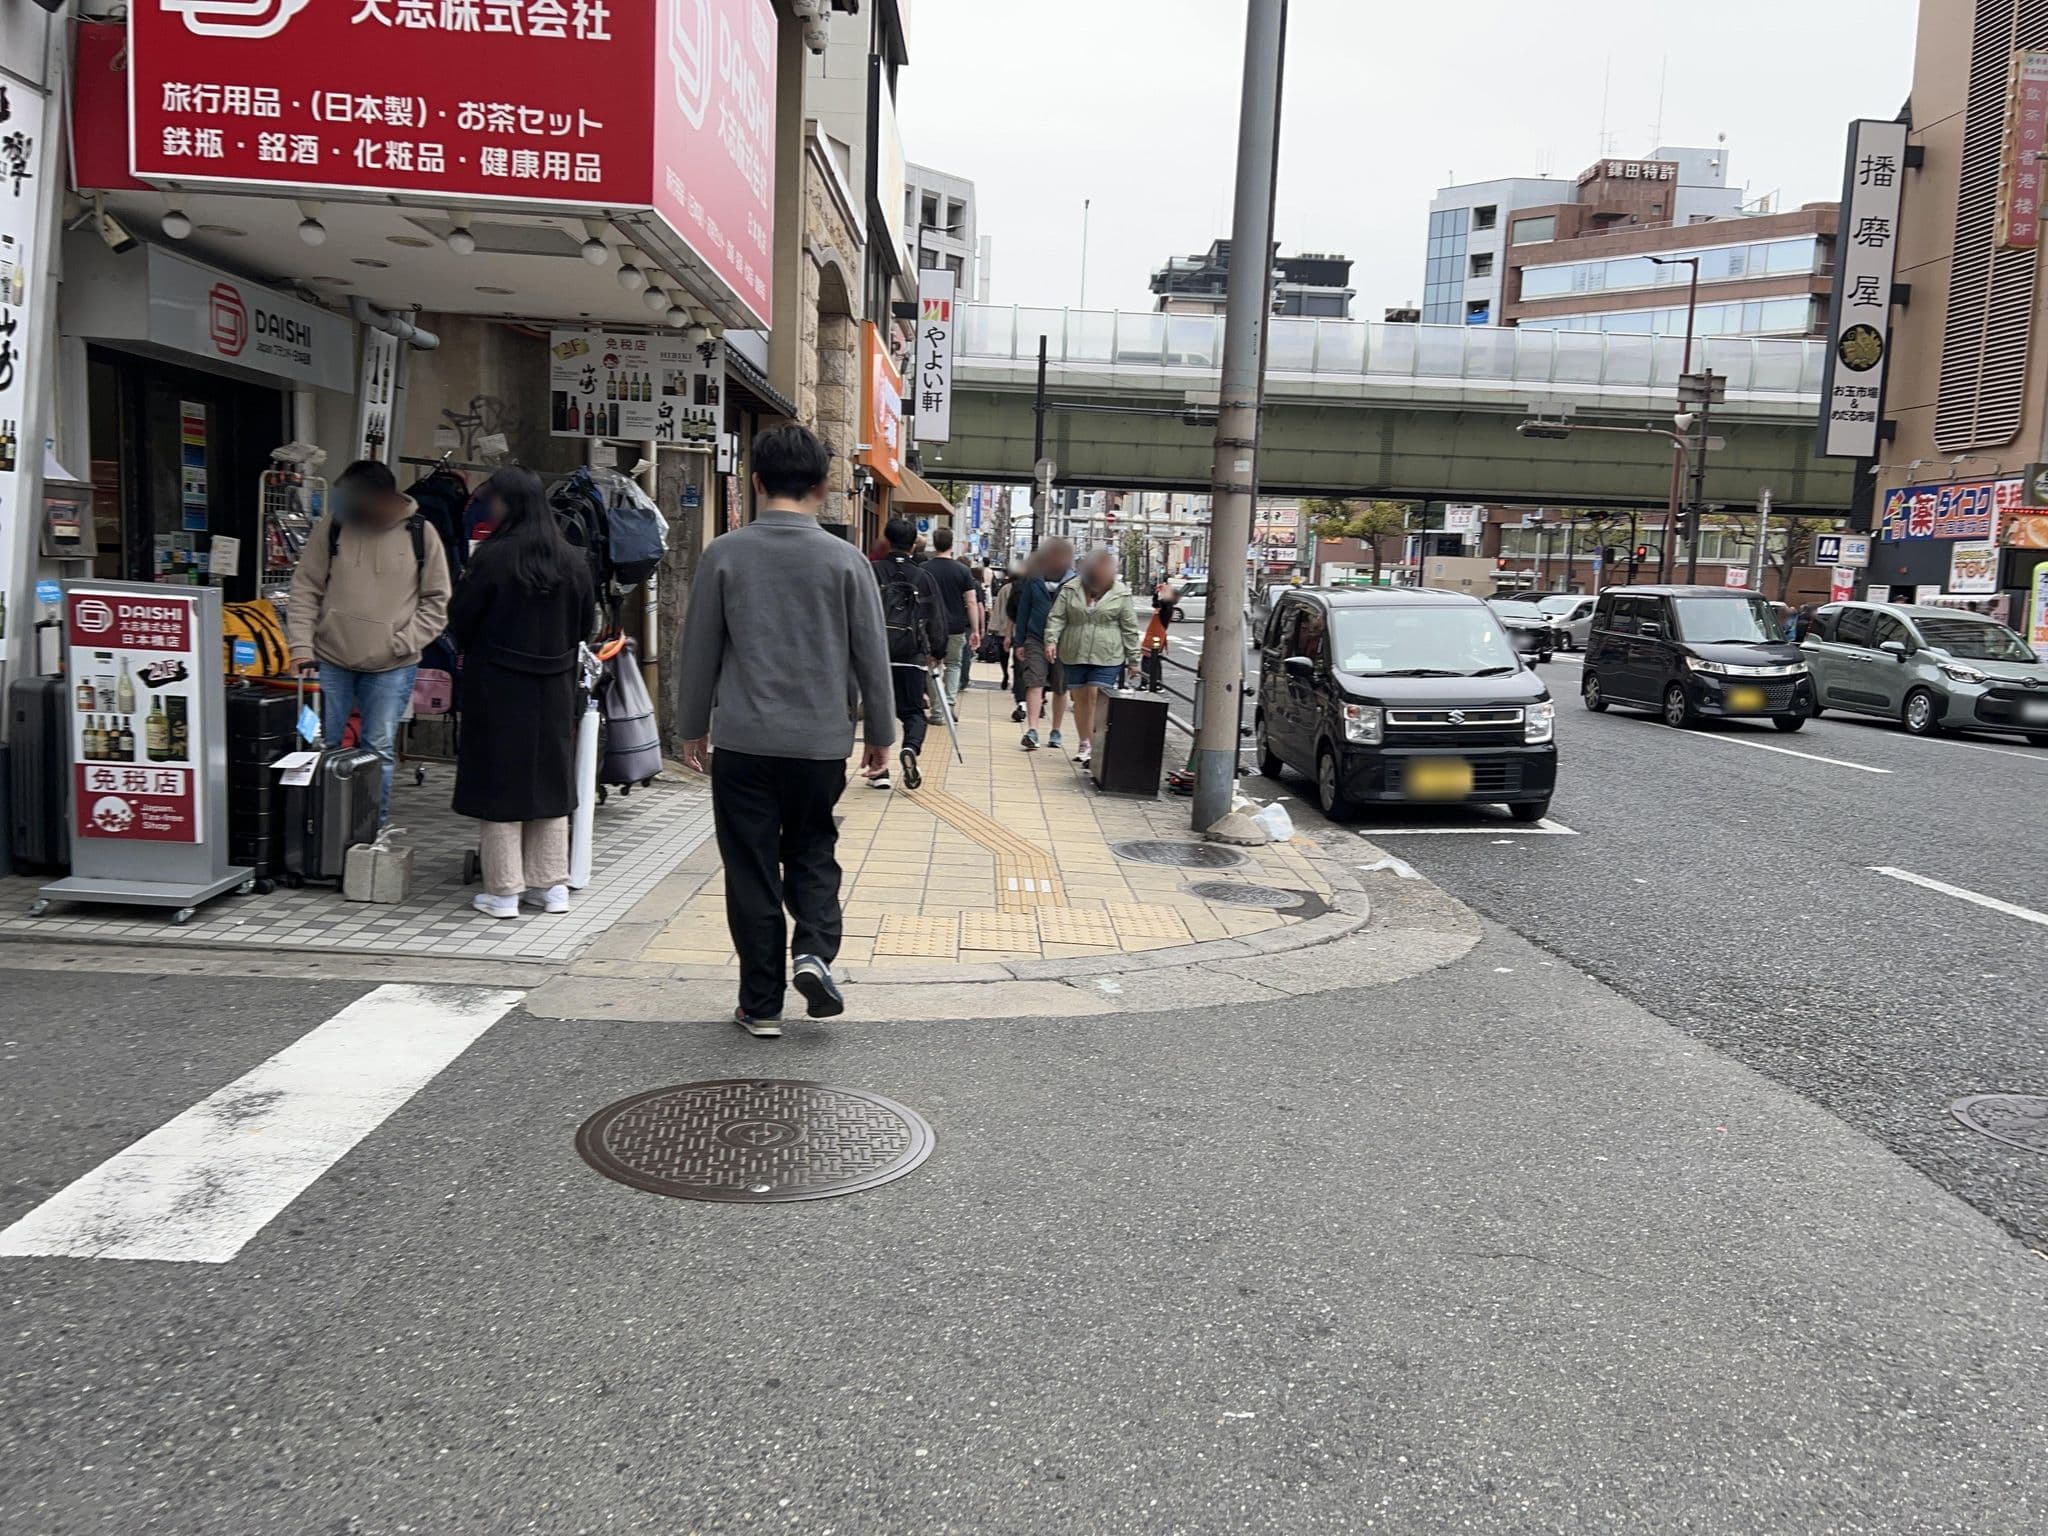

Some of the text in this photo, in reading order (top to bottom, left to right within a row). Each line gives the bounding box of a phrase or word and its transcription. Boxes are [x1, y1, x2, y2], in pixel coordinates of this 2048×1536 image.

[719, 9, 768, 157] DAISHI
[162, 126, 602, 183] 鉄瓶・銘酒・化粧品・健康用品
[1607, 161, 1676, 180] 鎌田特許
[1847, 153, 1897, 309] 播磨屋
[255, 308, 312, 348] DAISHI
[606, 337, 647, 351] 免税店
[921, 326, 946, 413] やよい軒
[1833, 385, 1879, 399] お玉市場
[1850, 398, 1859, 409] &
[654, 401, 674, 441] 白州
[117, 604, 183, 621] DAISHI
[92, 768, 180, 794] 免税店
[142, 821, 171, 831] Shop
